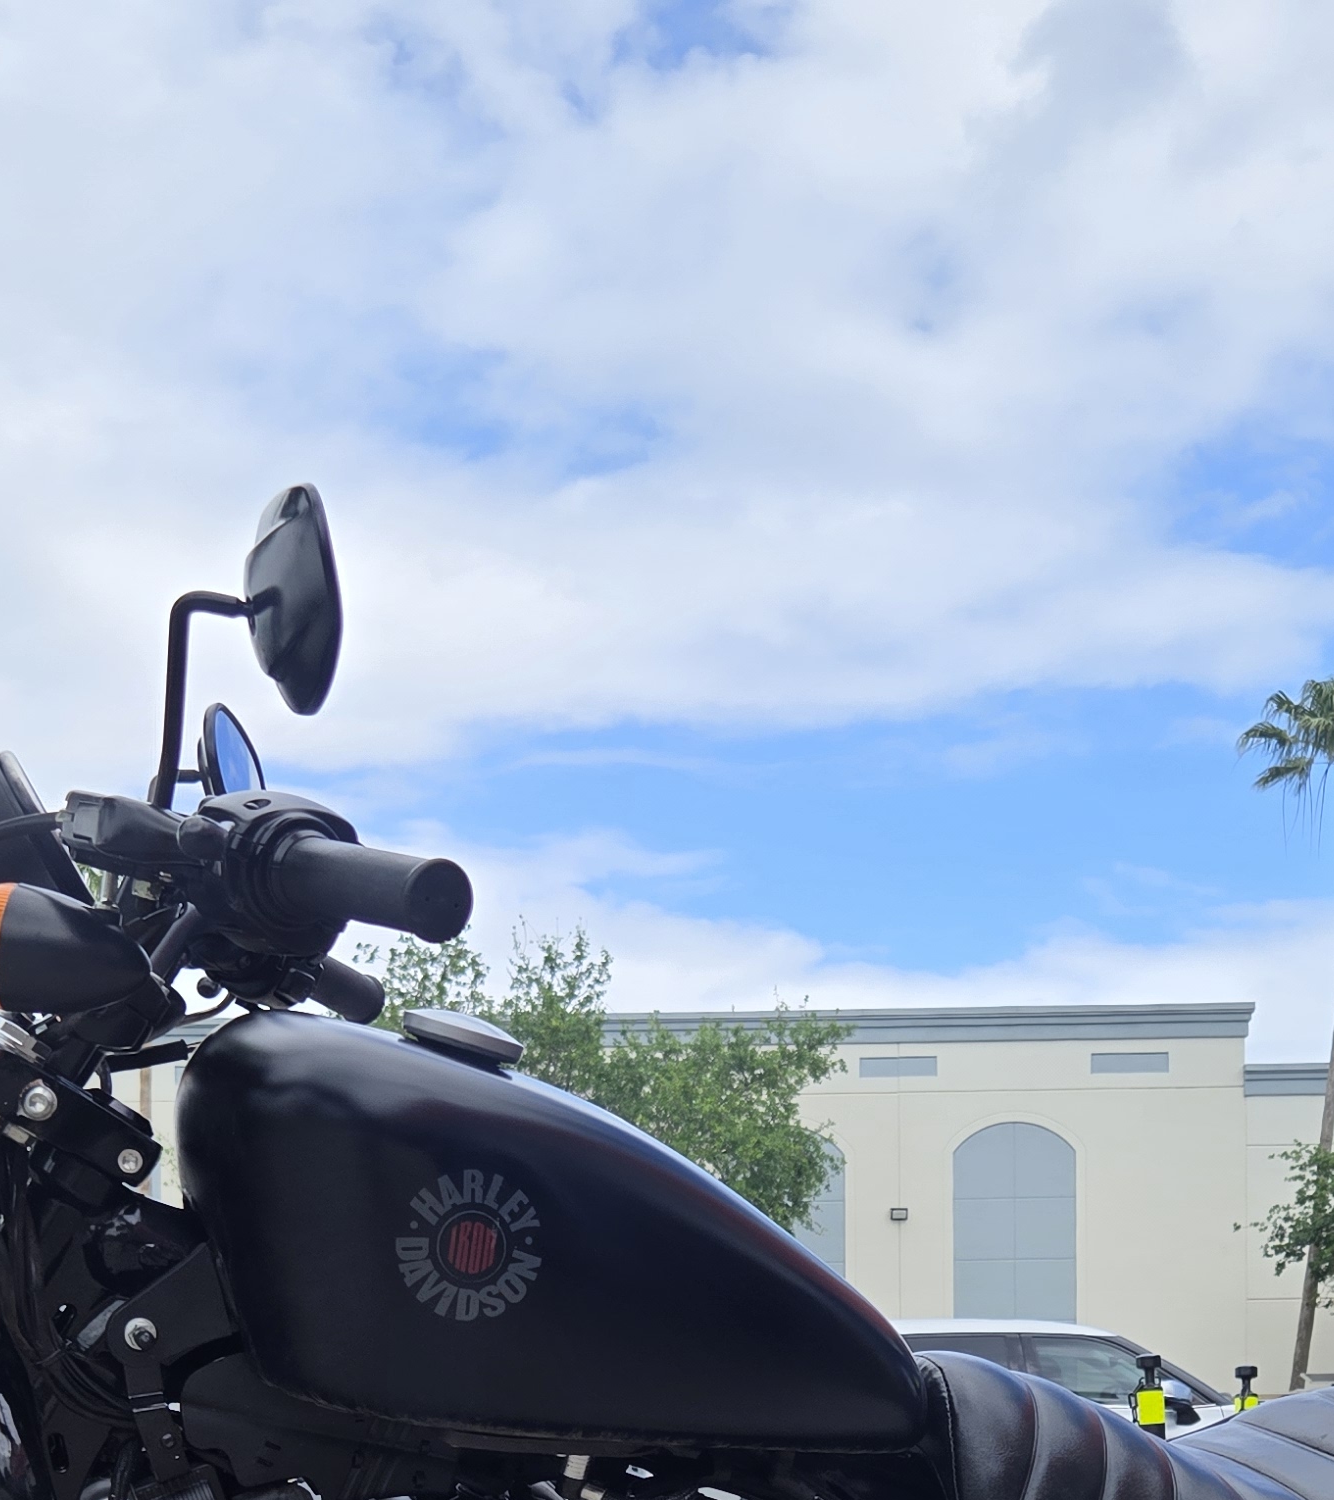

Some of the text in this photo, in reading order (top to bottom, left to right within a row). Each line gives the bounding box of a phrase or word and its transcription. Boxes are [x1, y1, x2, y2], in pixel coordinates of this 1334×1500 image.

[410, 1169, 541, 1232] HARLEY
[395, 1237, 543, 1321] DAVIDSON
[447, 1221, 497, 1275] IRON
